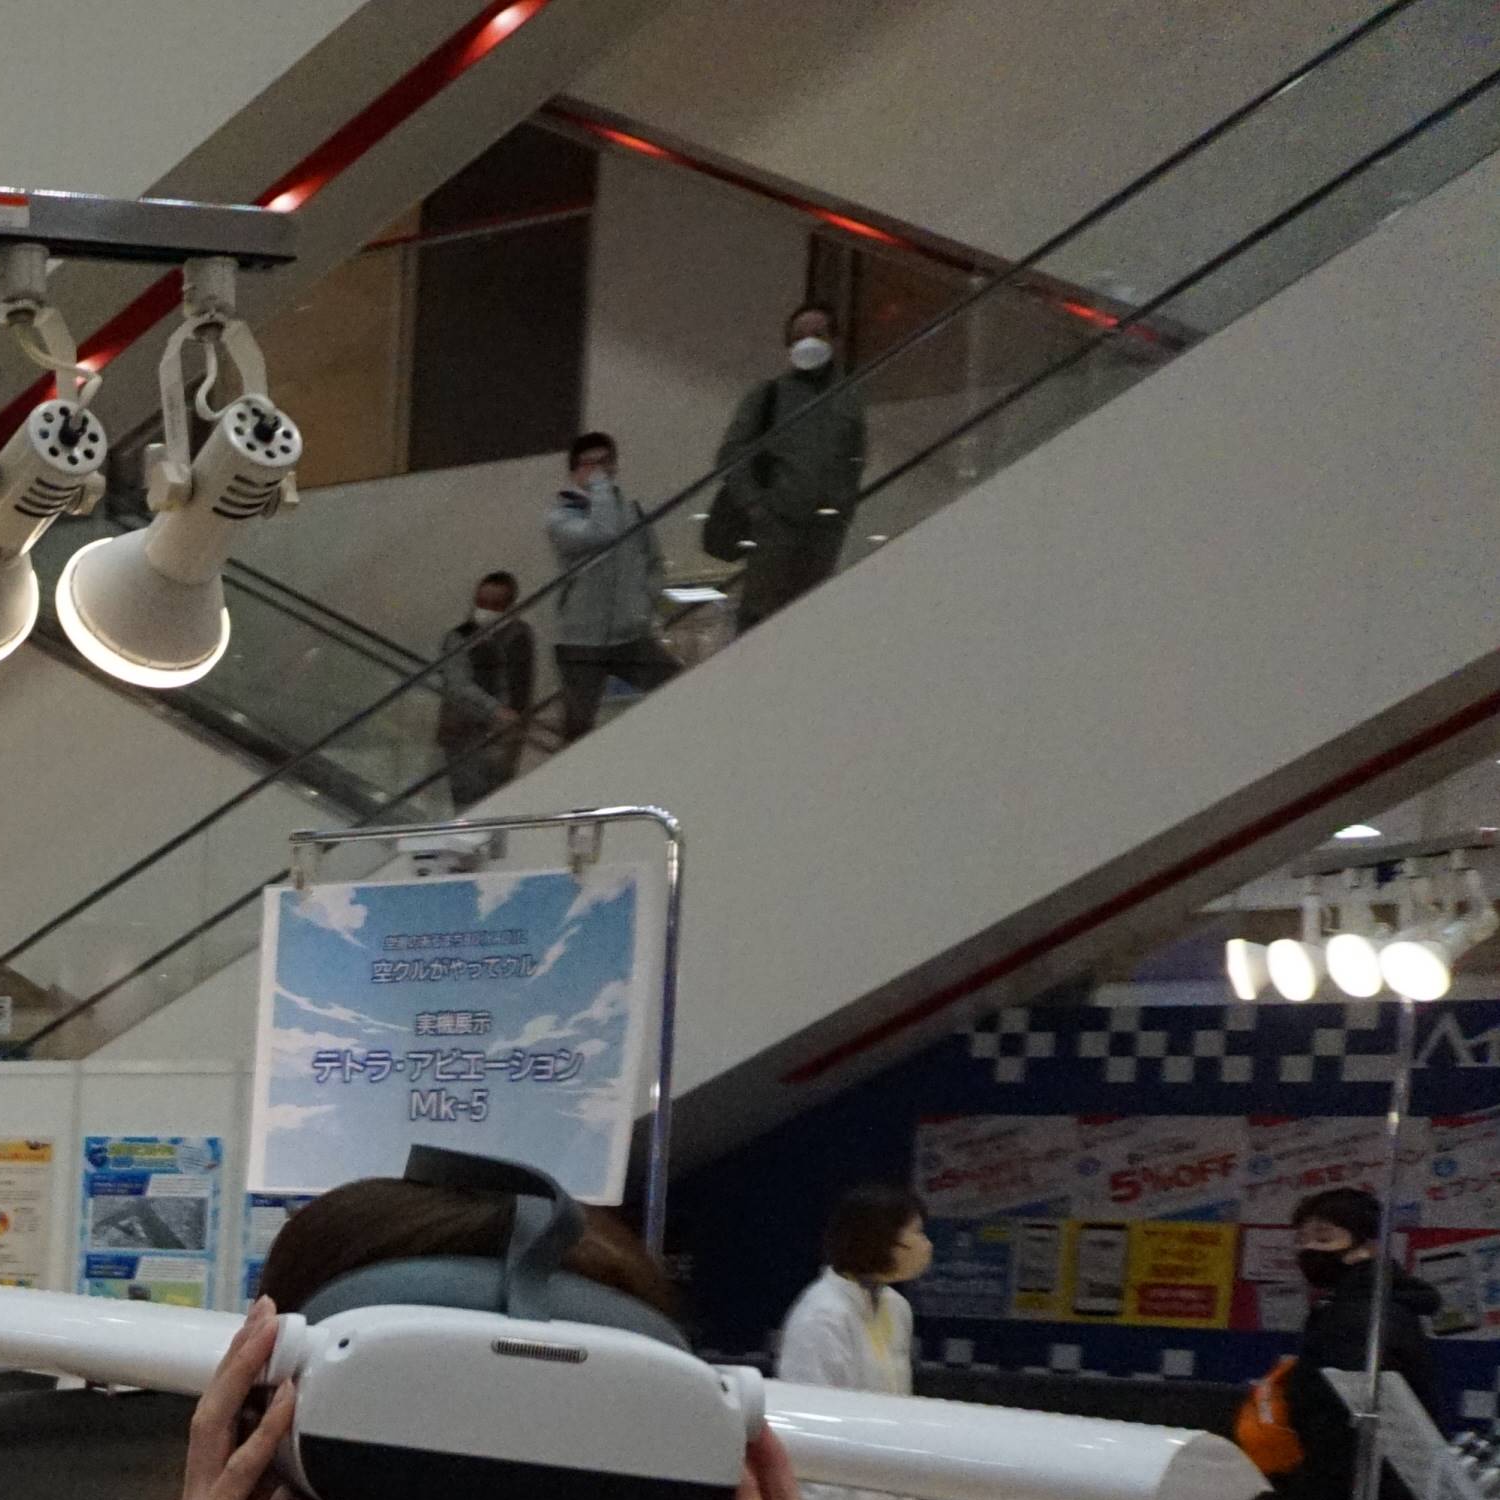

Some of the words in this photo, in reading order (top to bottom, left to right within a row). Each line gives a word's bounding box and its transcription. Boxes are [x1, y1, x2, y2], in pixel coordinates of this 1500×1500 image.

[371, 954, 538, 984] 空クルがやってクル
[414, 1010, 492, 1036] 実機展示
[312, 1047, 585, 1084] テトラ・アビエーション
[409, 1088, 490, 1122] Mk-5
